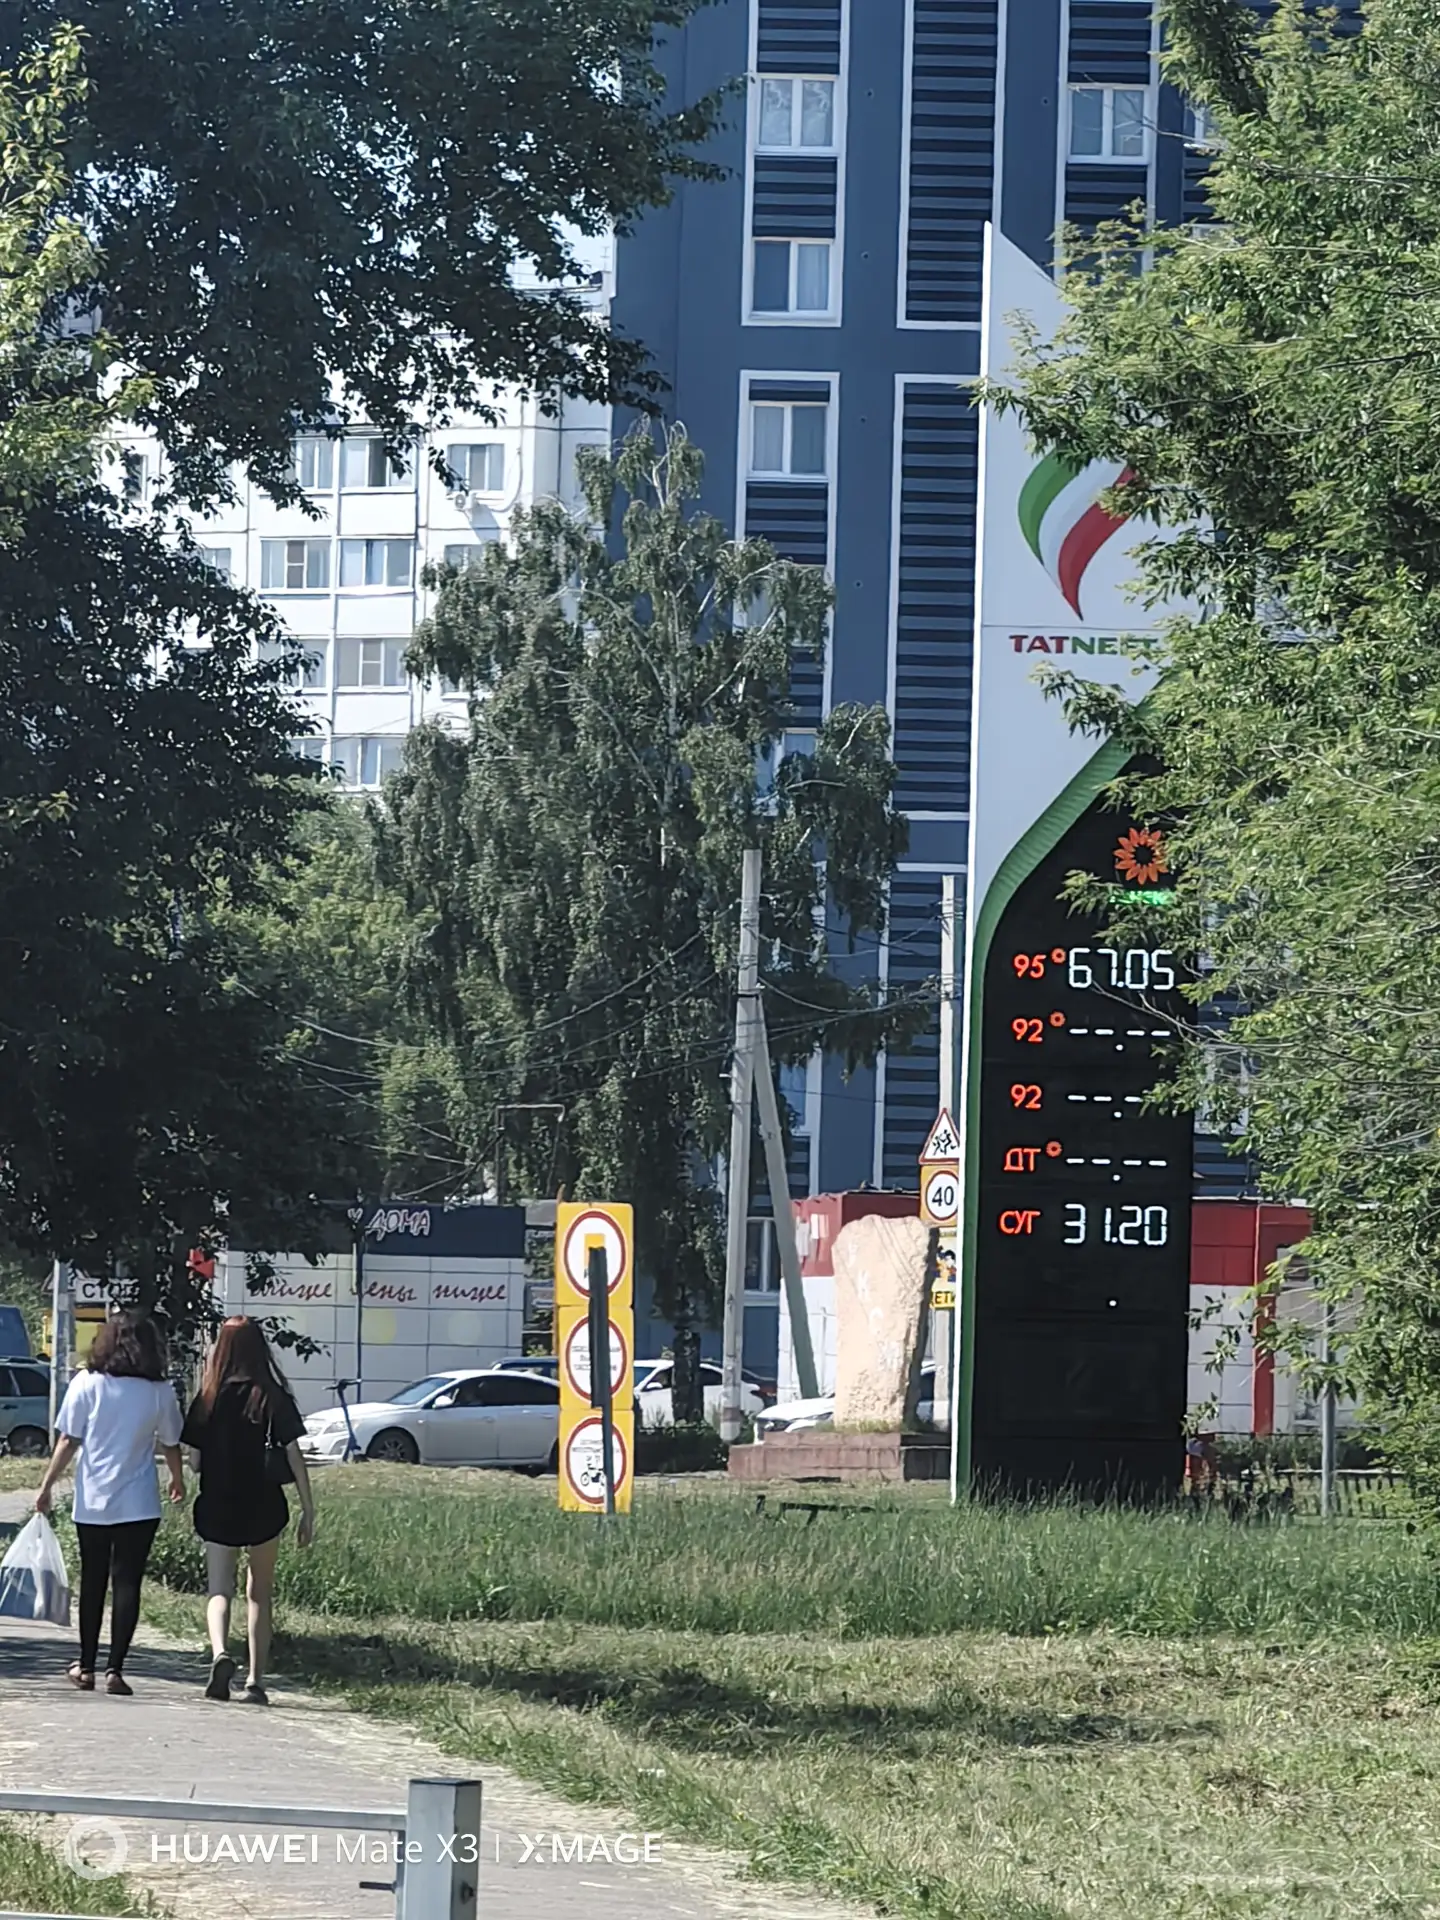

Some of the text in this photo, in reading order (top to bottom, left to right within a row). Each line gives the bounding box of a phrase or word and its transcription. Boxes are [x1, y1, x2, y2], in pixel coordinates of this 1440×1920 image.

[1013, 948, 1175, 990] 95 67.05
[1012, 1018, 1043, 1043] 92
[1010, 1084, 1042, 1109] 92
[1004, 1148, 1042, 1172] ДТ
[932, 1186, 955, 1207] 40
[364, 1208, 431, 1242] ДОМА
[999, 1203, 1168, 1246] СУГ 31.20
